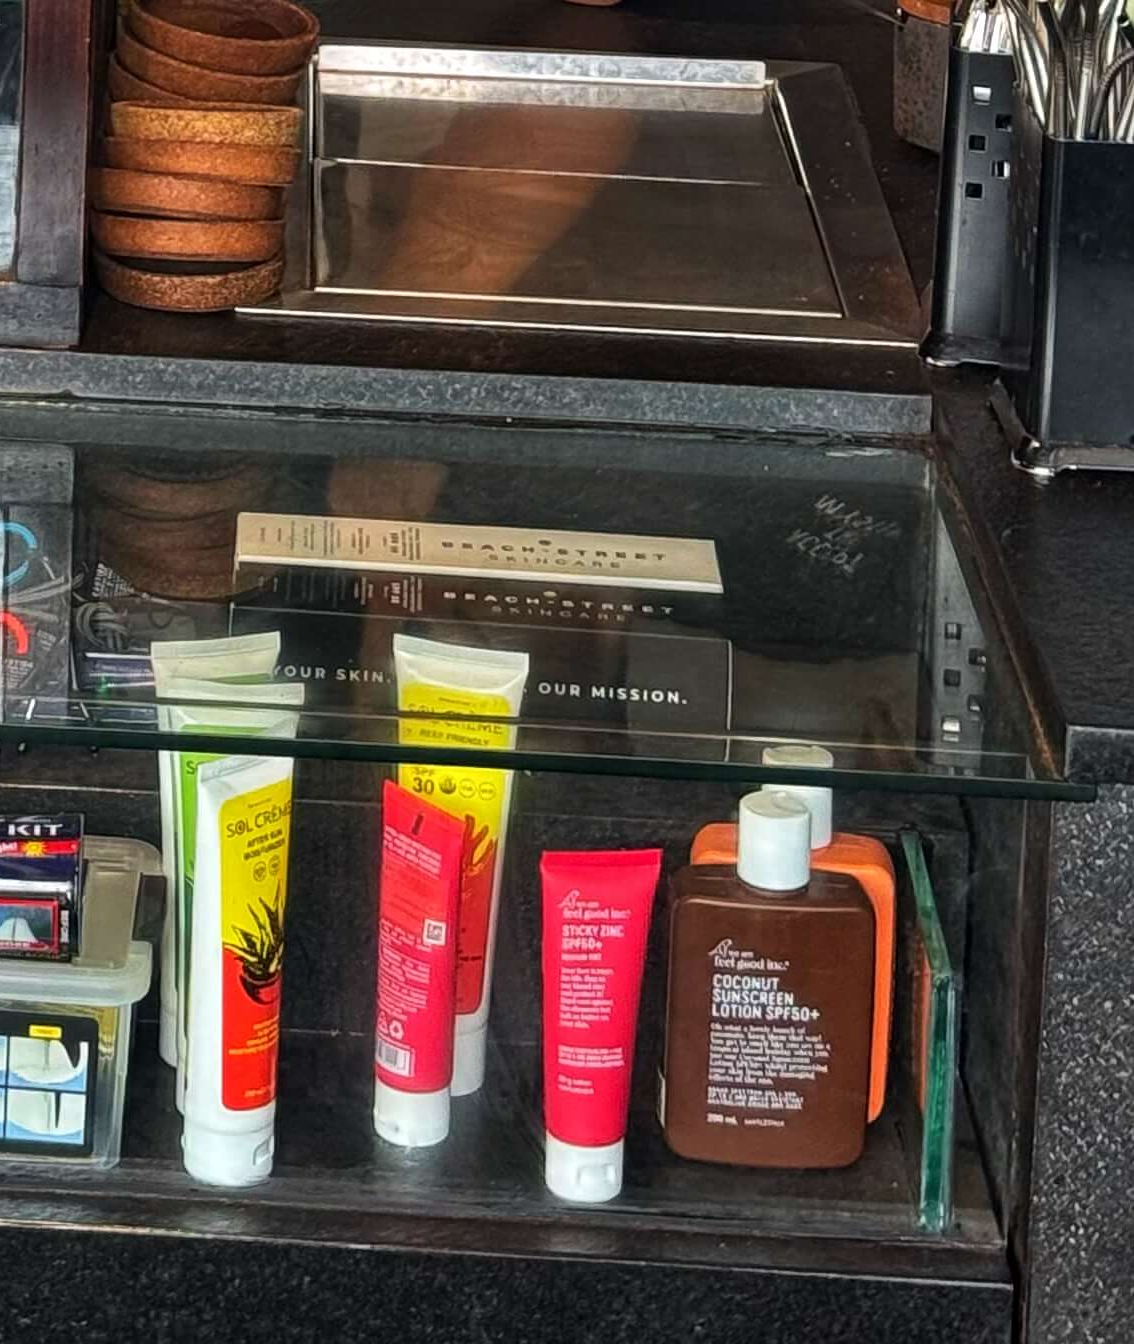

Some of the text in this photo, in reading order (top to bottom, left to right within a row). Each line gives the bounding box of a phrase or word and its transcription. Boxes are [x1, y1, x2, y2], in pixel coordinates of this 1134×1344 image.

[336, 667, 392, 684] SKIN.
[538, 681, 582, 697] OUR
[591, 685, 687, 705] MISSION.
[412, 776, 435, 796] 30
[8, 823, 63, 836] KIT
[562, 924, 626, 938] STICKY ZINC
[561, 938, 603, 949] SPF50+
[714, 955, 735, 968] feel
[736, 957, 765, 971] good
[712, 973, 780, 991] COCONUT
[712, 988, 794, 1006] SUNSCREEN
[711, 1002, 821, 1022] LOTION SPF50+
